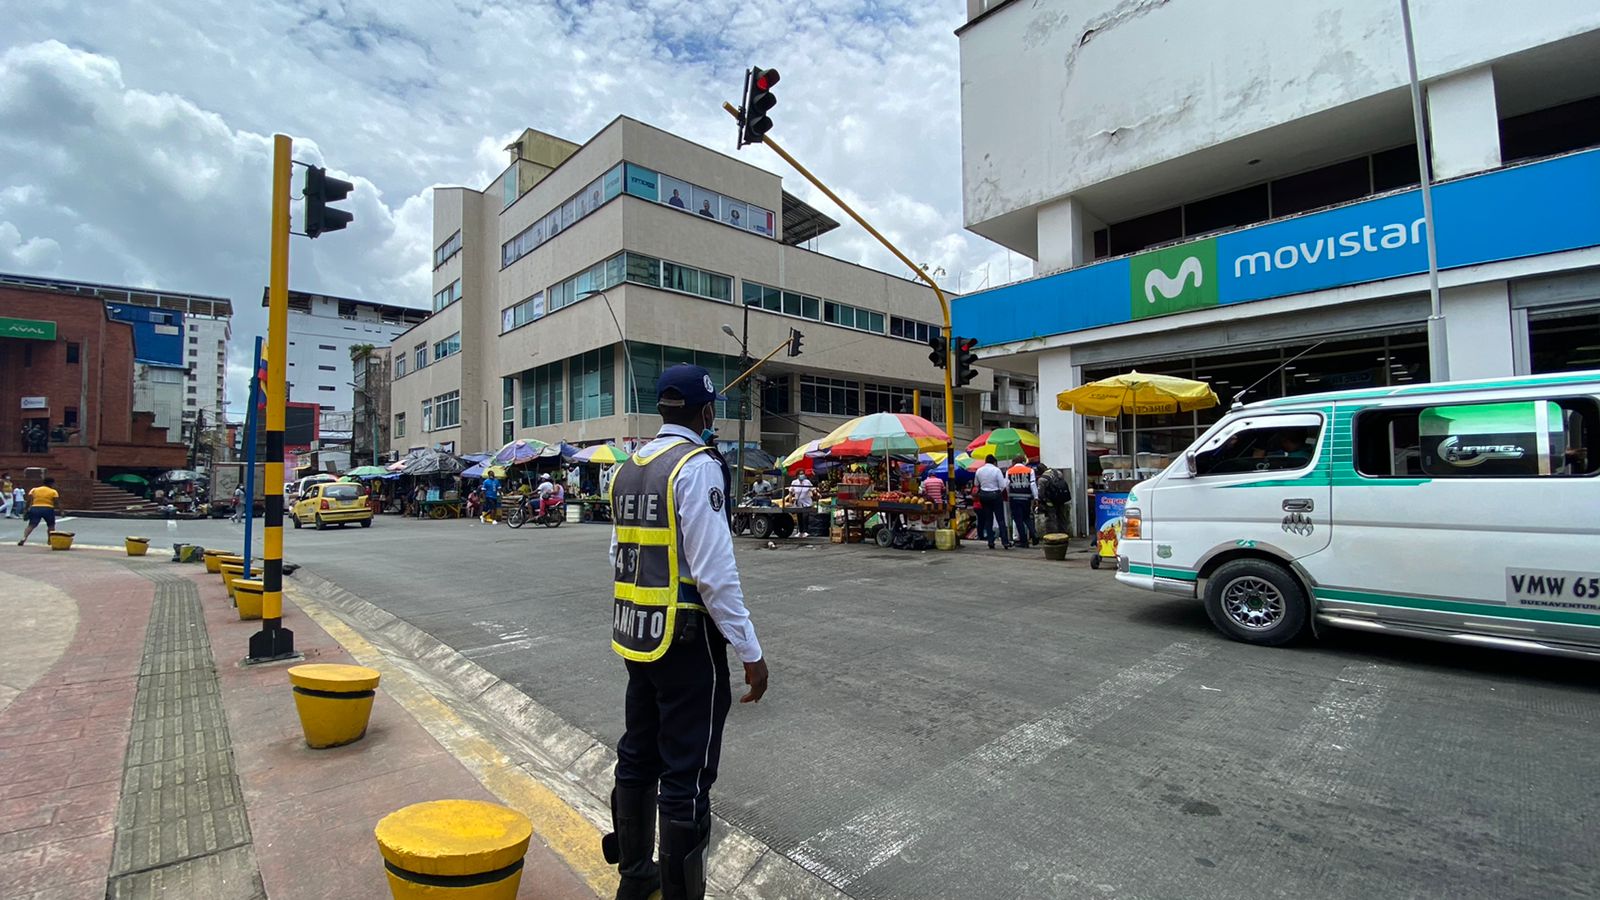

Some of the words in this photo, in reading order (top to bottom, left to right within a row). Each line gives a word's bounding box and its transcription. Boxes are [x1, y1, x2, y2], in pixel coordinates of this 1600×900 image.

[1234, 217, 1428, 278] movistar
[9, 325, 46, 335] AVAL
[1511, 575, 1566, 596] VMW
[1573, 577, 1600, 598] 65
